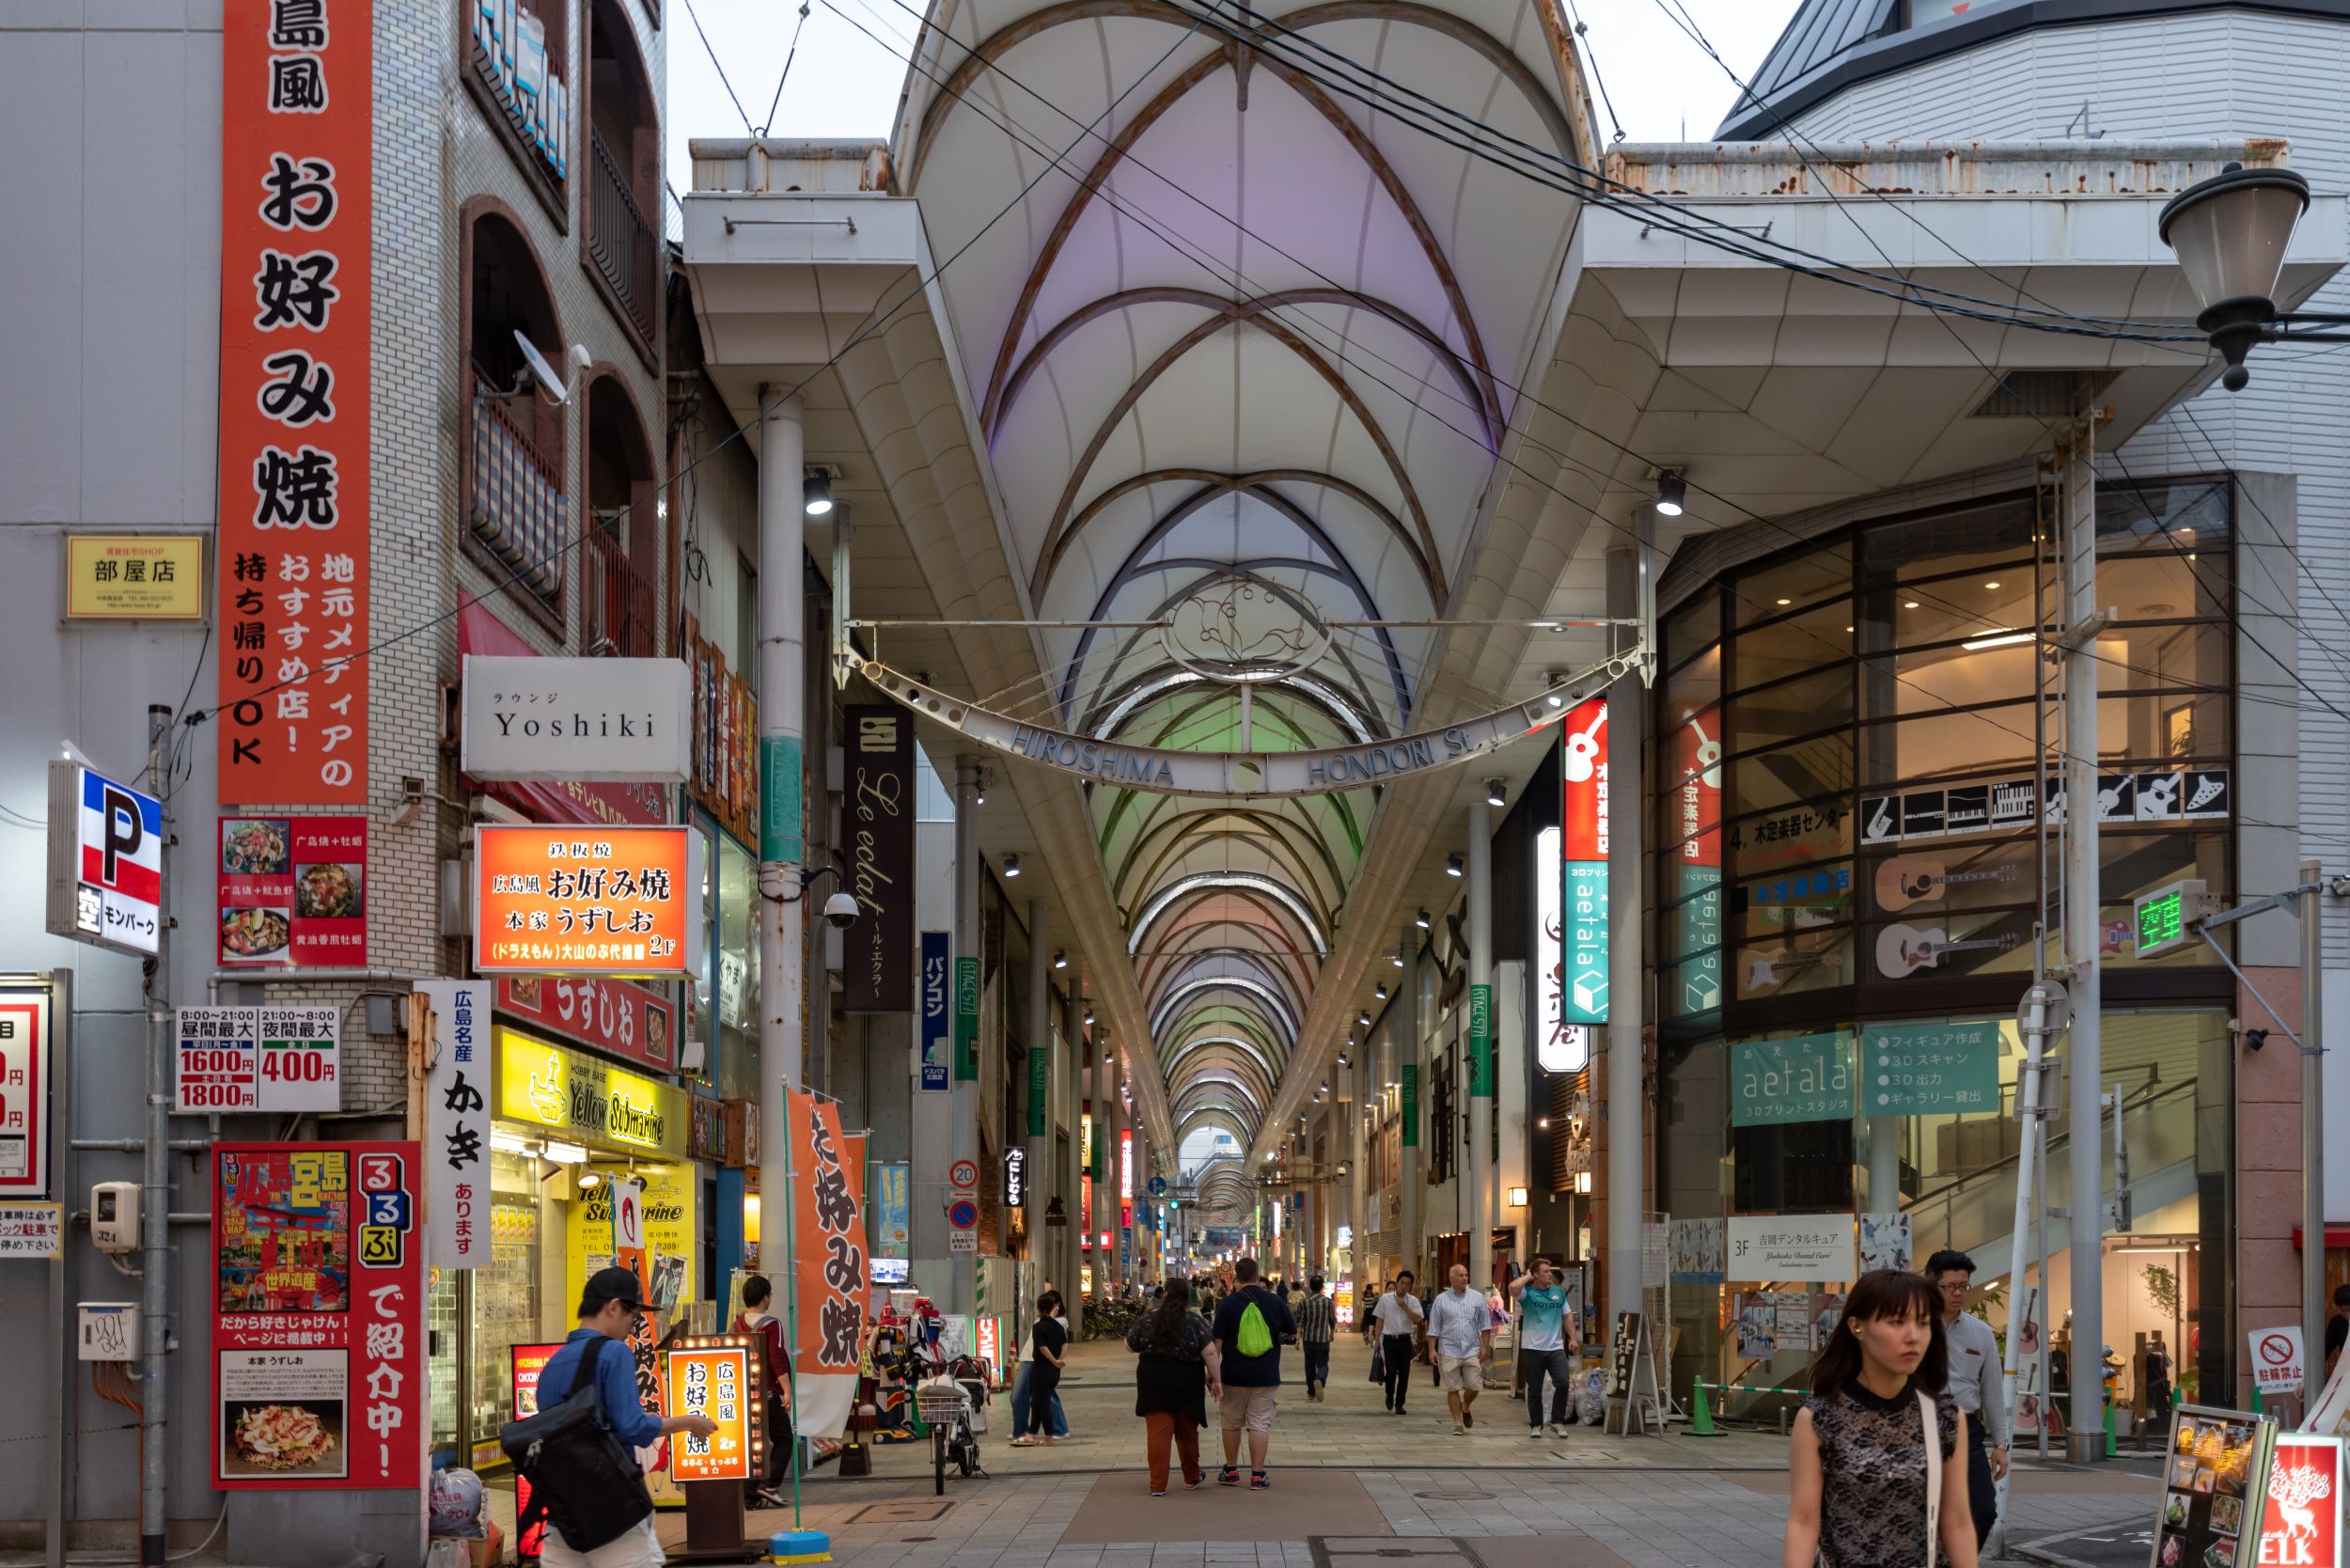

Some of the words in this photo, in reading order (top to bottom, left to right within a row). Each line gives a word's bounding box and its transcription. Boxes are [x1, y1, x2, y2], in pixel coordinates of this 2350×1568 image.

[257, 155, 337, 526] お好み焼
[95, 560, 175, 582] 部屋店
[277, 554, 309, 752] おすすめ店！
[321, 554, 354, 787] 地元メディアの
[494, 693, 557, 704] ラウンジ
[494, 713, 654, 736] Yoshiki
[1010, 725, 1174, 784] HIROSHIMA
[1308, 736, 1434, 785] HONDORI
[1444, 729, 1481, 757] St.
[103, 785, 143, 886] P
[549, 842, 611, 857] 鉄板焼
[493, 874, 540, 894] 広島風
[547, 867, 670, 902] お好み焼
[505, 911, 548, 931] 本家
[556, 906, 655, 934] うずしお
[1576, 884, 1599, 965] aetala
[649, 935, 676, 956] 2F
[926, 955, 945, 1018] パソコン
[181, 1022, 254, 1038] 昼間最大
[262, 1022, 334, 1038] 夜間最大
[455, 990, 473, 1062] 広島名産
[1744, 1038, 1843, 1059] あえたら
[1891, 1032, 1982, 1049] フィギュア作成
[180, 1051, 254, 1072] 1600円
[262, 1051, 335, 1082] 400円
[571, 1063, 589, 1079] HOBBY
[592, 1069, 606, 1084] BASE
[1744, 1056, 1846, 1098] aetala
[180, 1085, 254, 1106] 1800円
[1890, 1090, 1982, 1105] ギャラリー貸出
[445, 1070, 483, 1170] かき
[569, 1080, 608, 1131] Yellow
[609, 1090, 665, 1146] Submarine
[955, 1168, 973, 1182] 20
[364, 1158, 401, 1261] るるぶ
[455, 1183, 472, 1255] あります
[1735, 1240, 1749, 1257] 3F
[1759, 1232, 1838, 1247] 吉岡デンタルキュア
[265, 1273, 317, 1292] 世界遺産
[221, 1316, 349, 1329] だから好きじゃけん！
[248, 1356, 265, 1366] 本家
[366, 1284, 404, 1478] で紹介中！
[717, 1363, 736, 1420] 広島風
[2258, 1538, 2314, 1565] ELK
